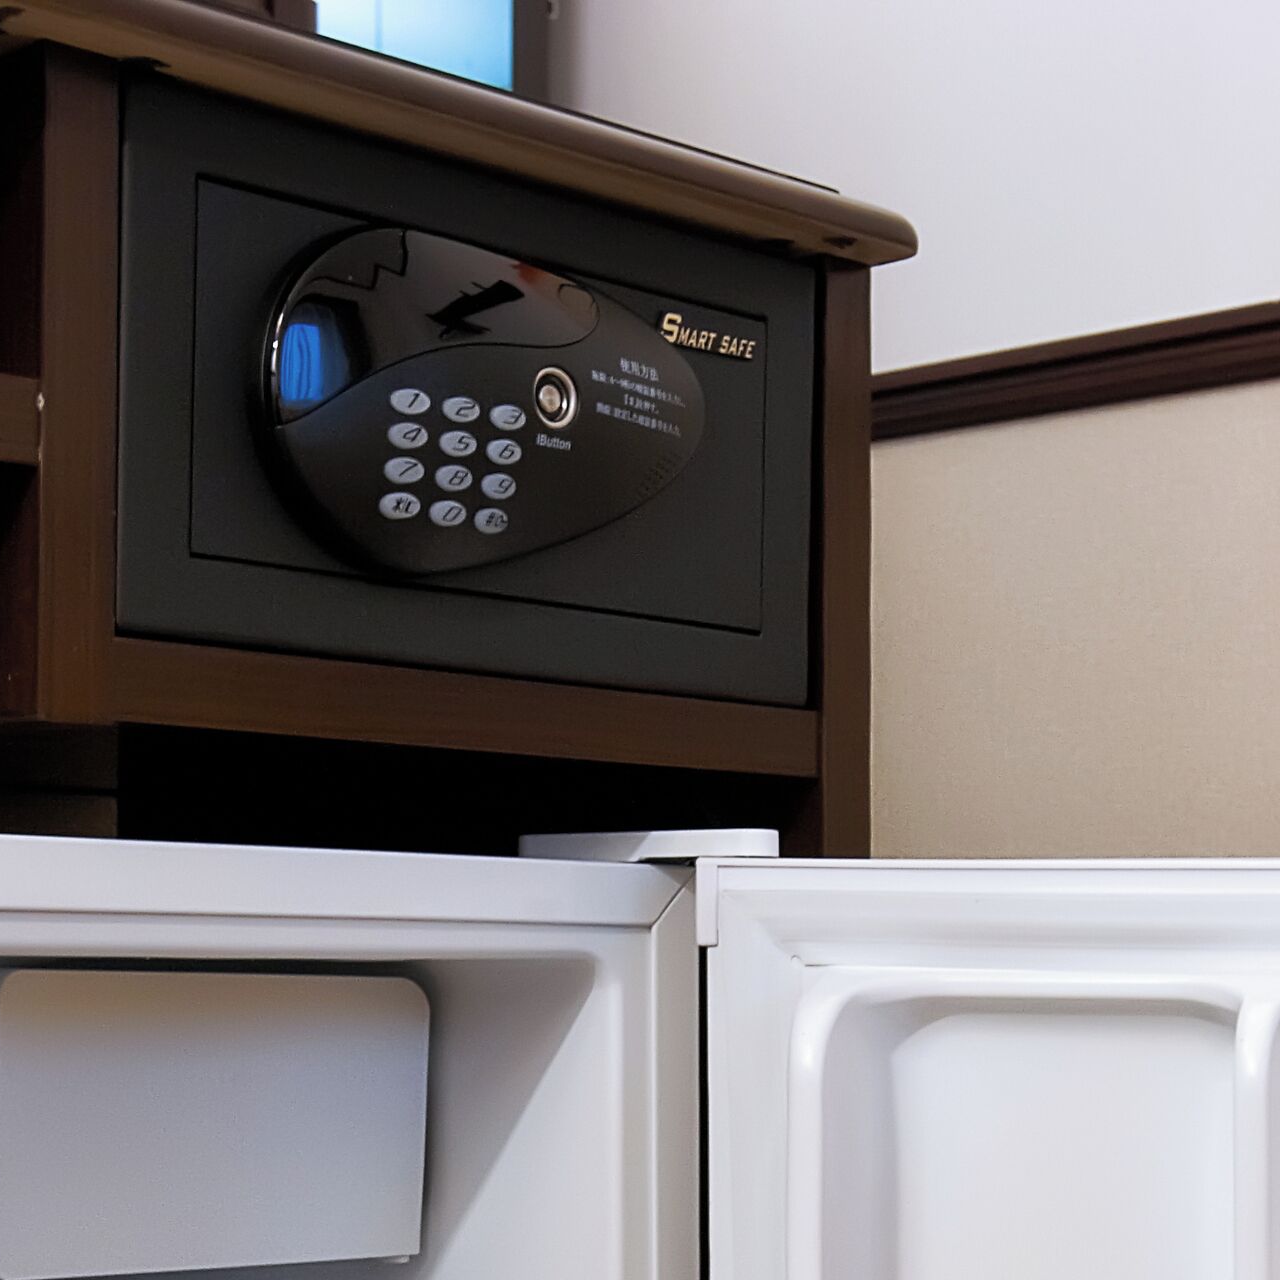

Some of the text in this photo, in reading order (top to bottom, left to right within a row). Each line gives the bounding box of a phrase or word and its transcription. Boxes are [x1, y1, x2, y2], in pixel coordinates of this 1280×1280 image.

[661, 312, 756, 359] SMART SAFE
[455, 401, 475, 417] 2
[503, 408, 523, 424] 3
[403, 427, 515, 460] 4 5 6
[399, 461, 513, 494] 7 8 9
